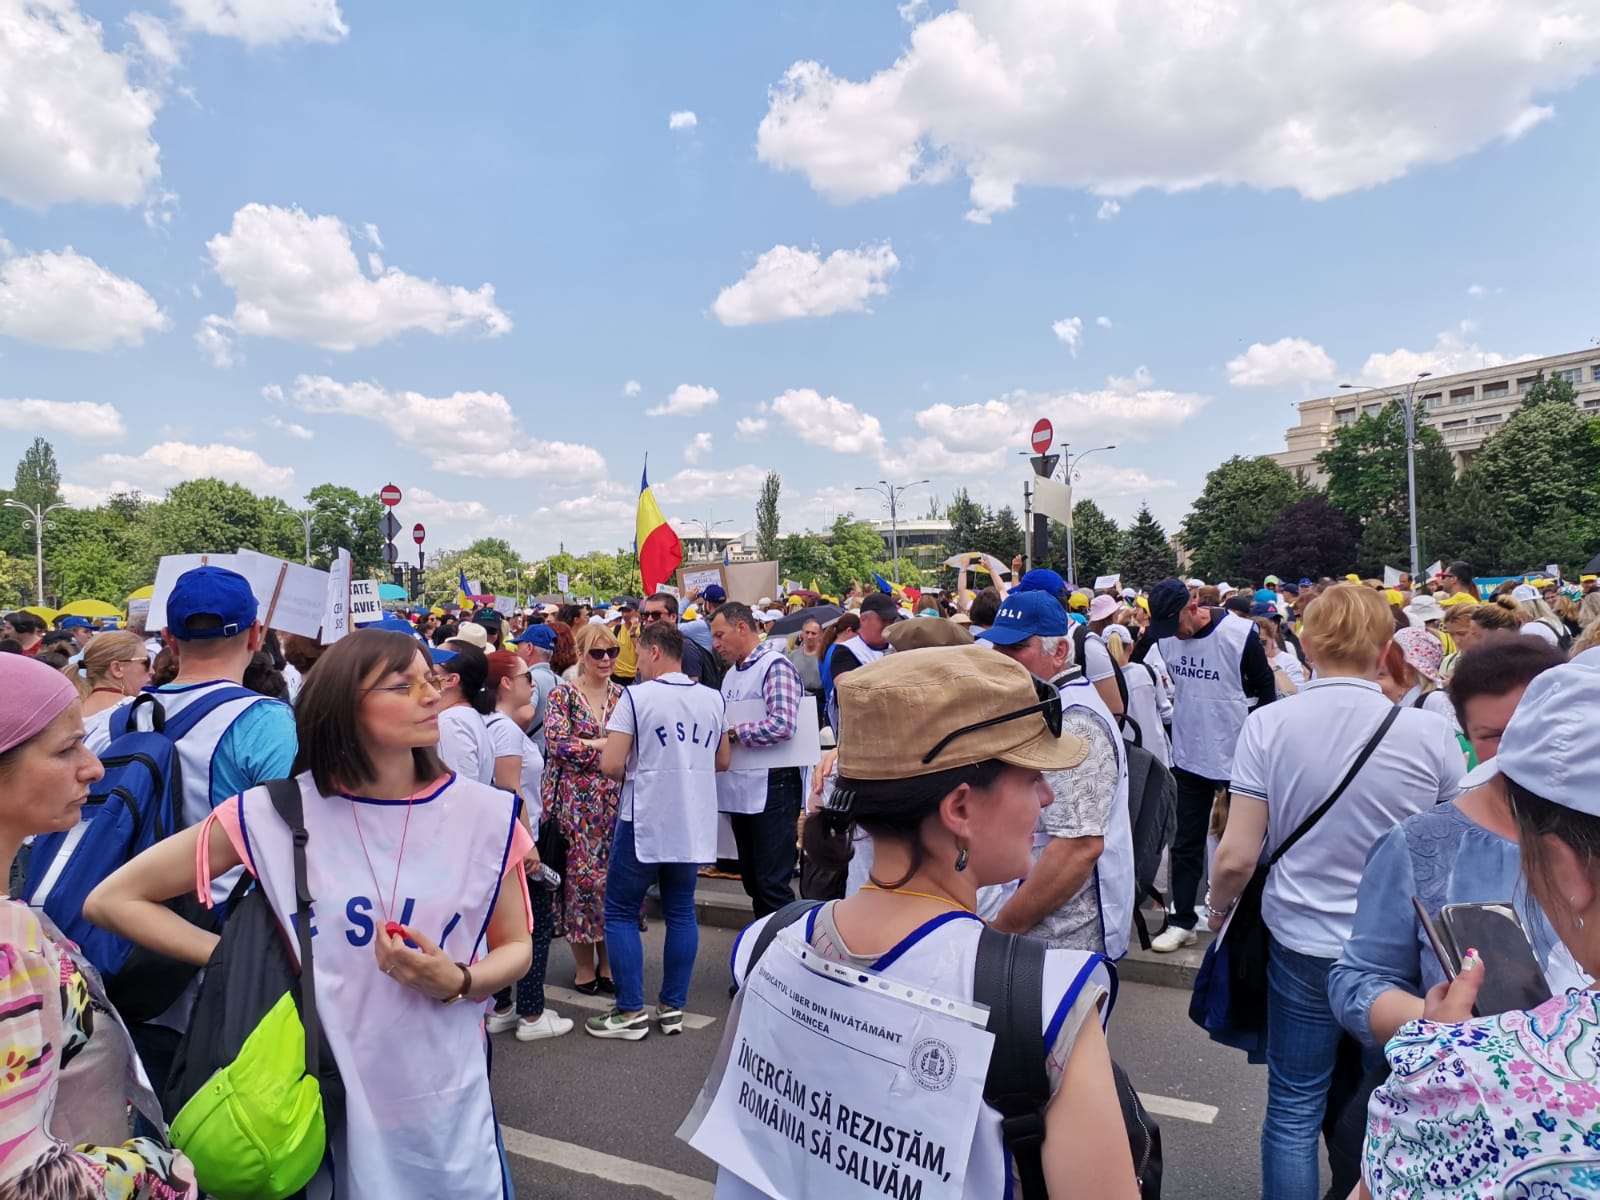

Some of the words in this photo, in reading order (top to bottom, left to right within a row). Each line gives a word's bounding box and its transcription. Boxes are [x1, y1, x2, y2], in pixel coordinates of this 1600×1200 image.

[1170, 663, 1220, 681] VRANCEA
[655, 722, 713, 748] FSLI
[758, 966, 789, 995] SINDICATUL
[789, 989, 810, 1009] LIBER
[811, 1002, 827, 1017] DIN
[791, 1006, 830, 1034] VRANCEA
[737, 1037, 807, 1111] ÎNCERCĂM
[809, 1090, 832, 1125] SĂ
[836, 1103, 952, 1183] REZISTĂM,
[738, 1081, 806, 1148] ROMÂNIA
[809, 1129, 832, 1164] SĂ
[835, 1144, 923, 1200] SALVĂM
